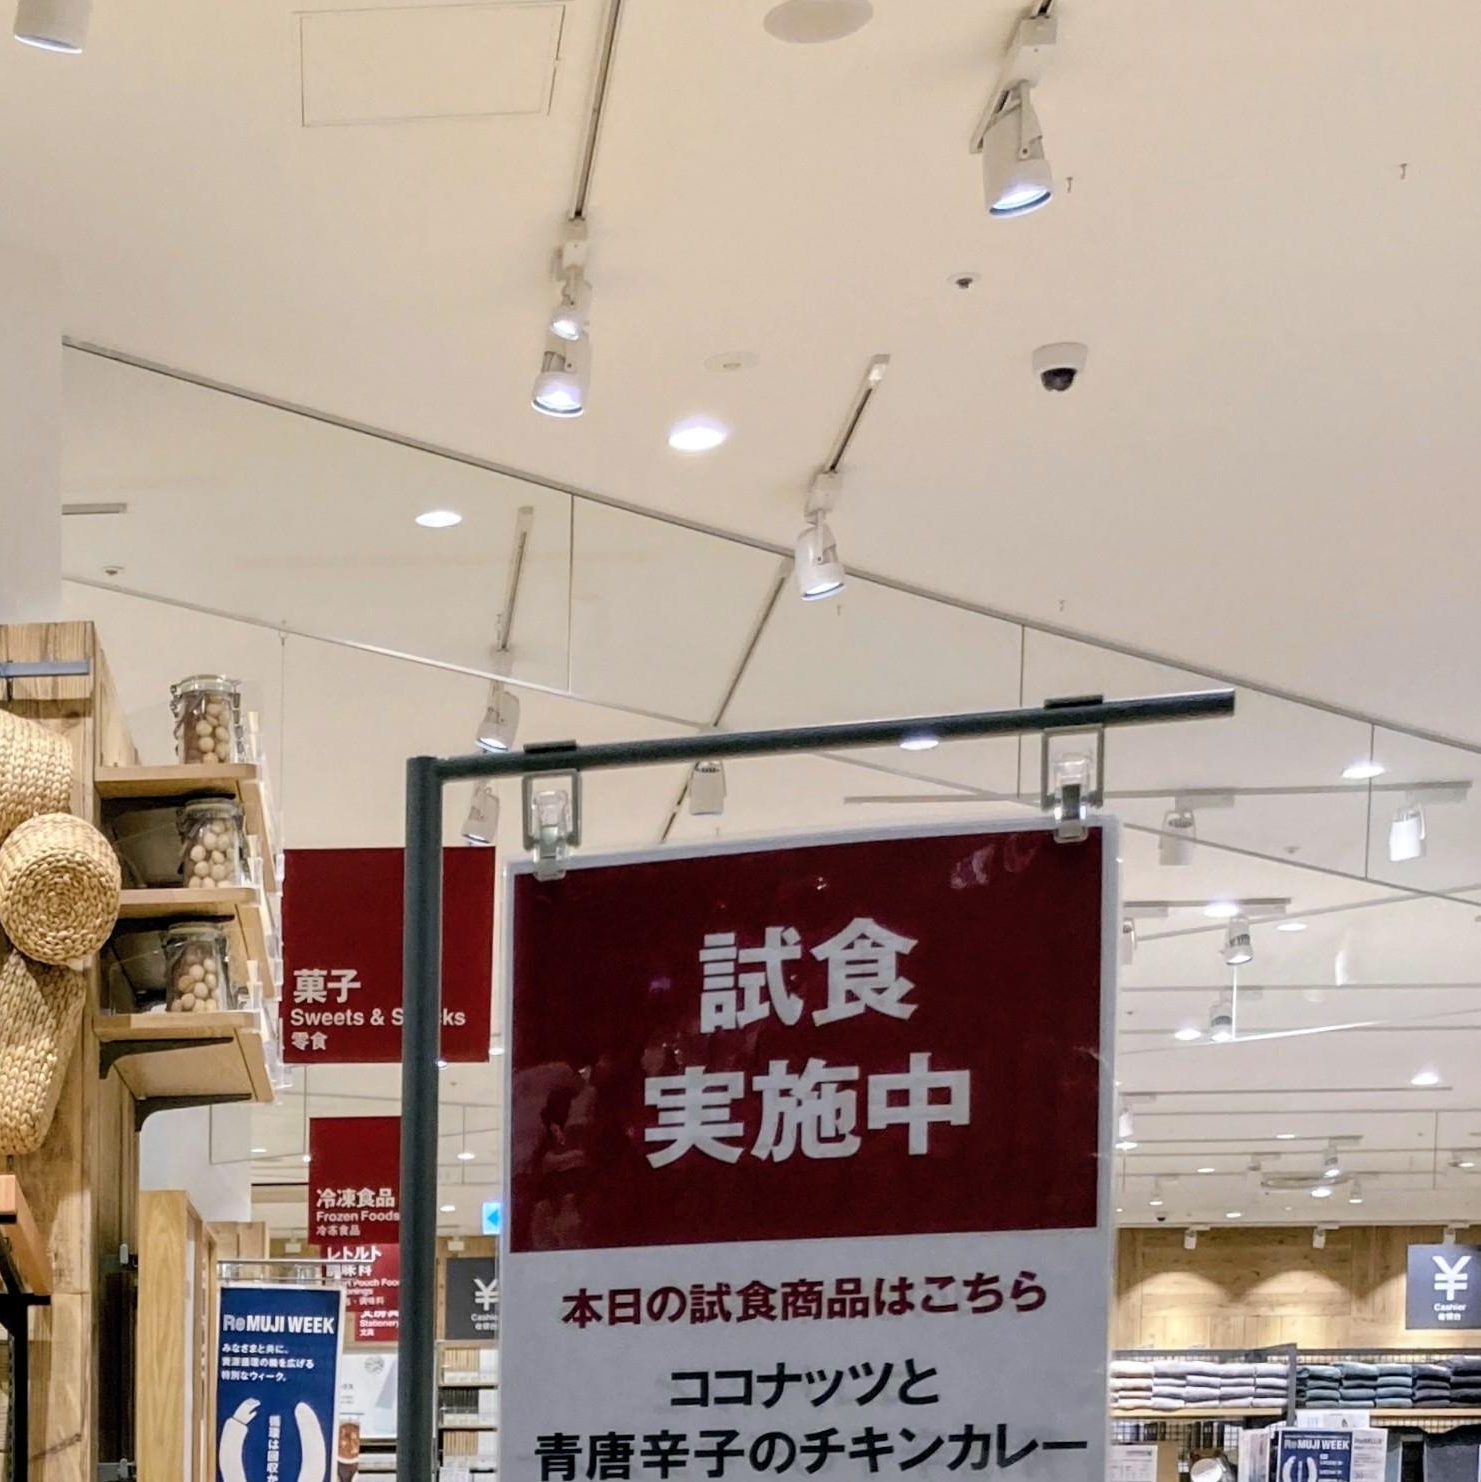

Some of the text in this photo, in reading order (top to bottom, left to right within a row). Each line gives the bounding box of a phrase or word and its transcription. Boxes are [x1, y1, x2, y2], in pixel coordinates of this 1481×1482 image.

[293, 968, 361, 1004] 菓子
[699, 918, 918, 1034] 試食
[290, 1008, 466, 1026] Sweets & Sks
[291, 1032, 328, 1050] 零食
[643, 1052, 971, 1169] 実施中
[316, 1187, 395, 1208] 冷凍食品
[316, 1210, 400, 1222] Frozen Foods
[327, 1245, 382, 1262] レトルト
[562, 1270, 1048, 1329] 本日の試食商品はこちら
[1433, 1303, 1467, 1312] Cashier
[222, 1314, 335, 1334] ReMUJI WEEK
[471, 1313, 498, 1322] Cashie
[670, 1358, 940, 1409] ココナッツと
[534, 1423, 1088, 1482] 青唐辛子のチキンカレー
[1321, 1439, 1350, 1450] WEEK
